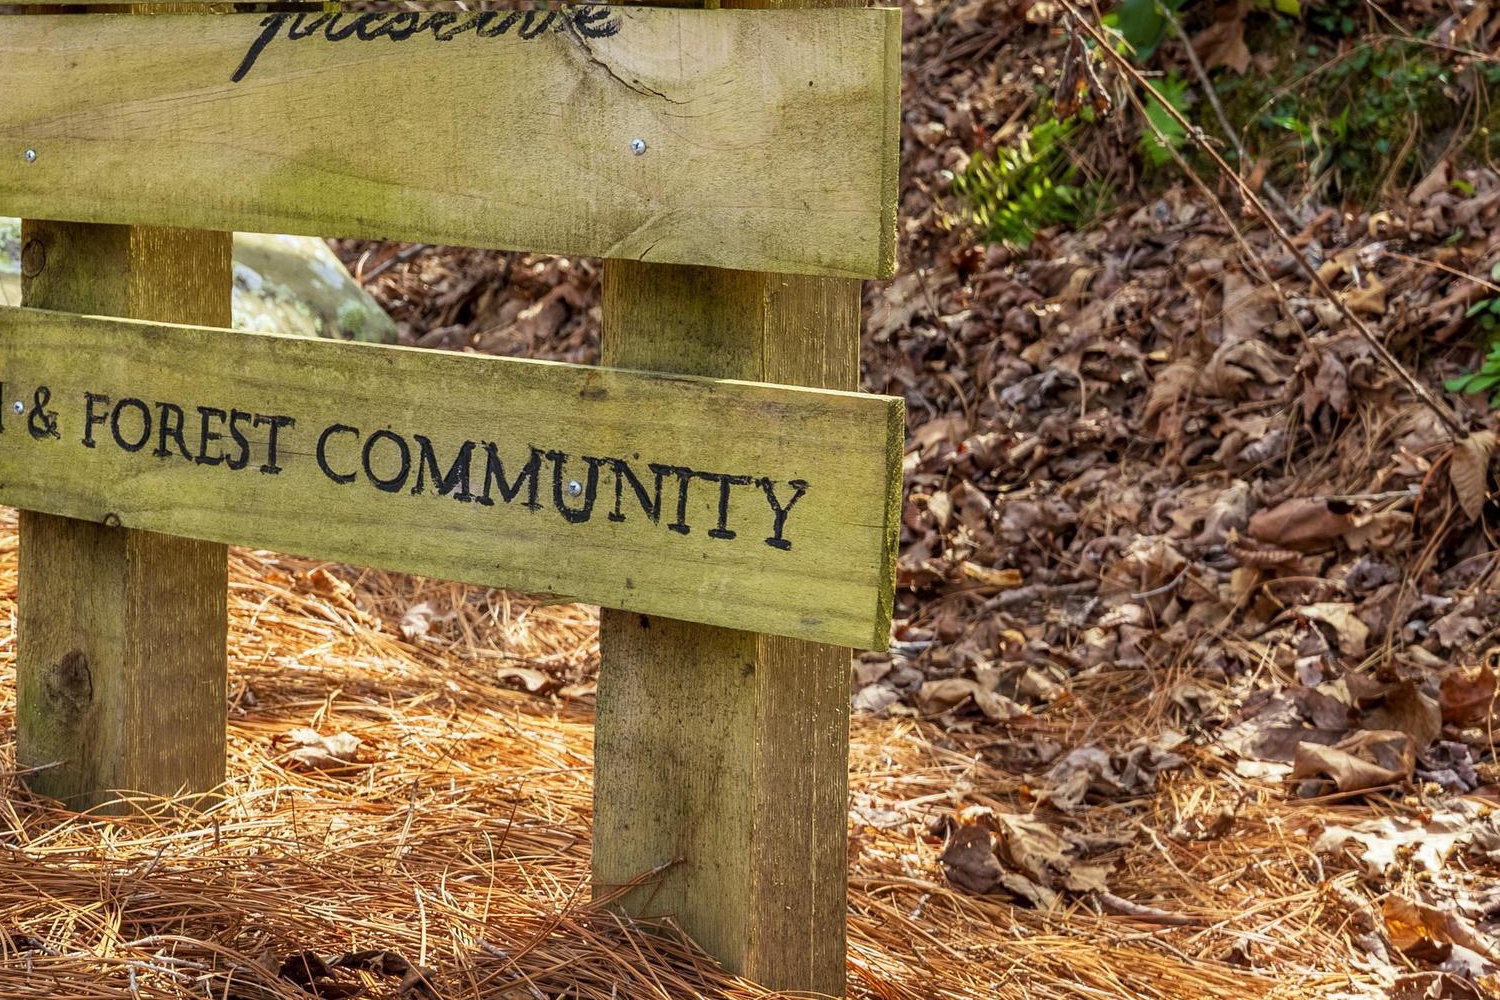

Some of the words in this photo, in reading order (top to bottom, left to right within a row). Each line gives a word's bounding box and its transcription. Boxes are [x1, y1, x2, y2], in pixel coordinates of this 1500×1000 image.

[28, 386, 62, 440] &
[81, 391, 296, 475] FOREST
[316, 423, 811, 550] COMMUNITY
